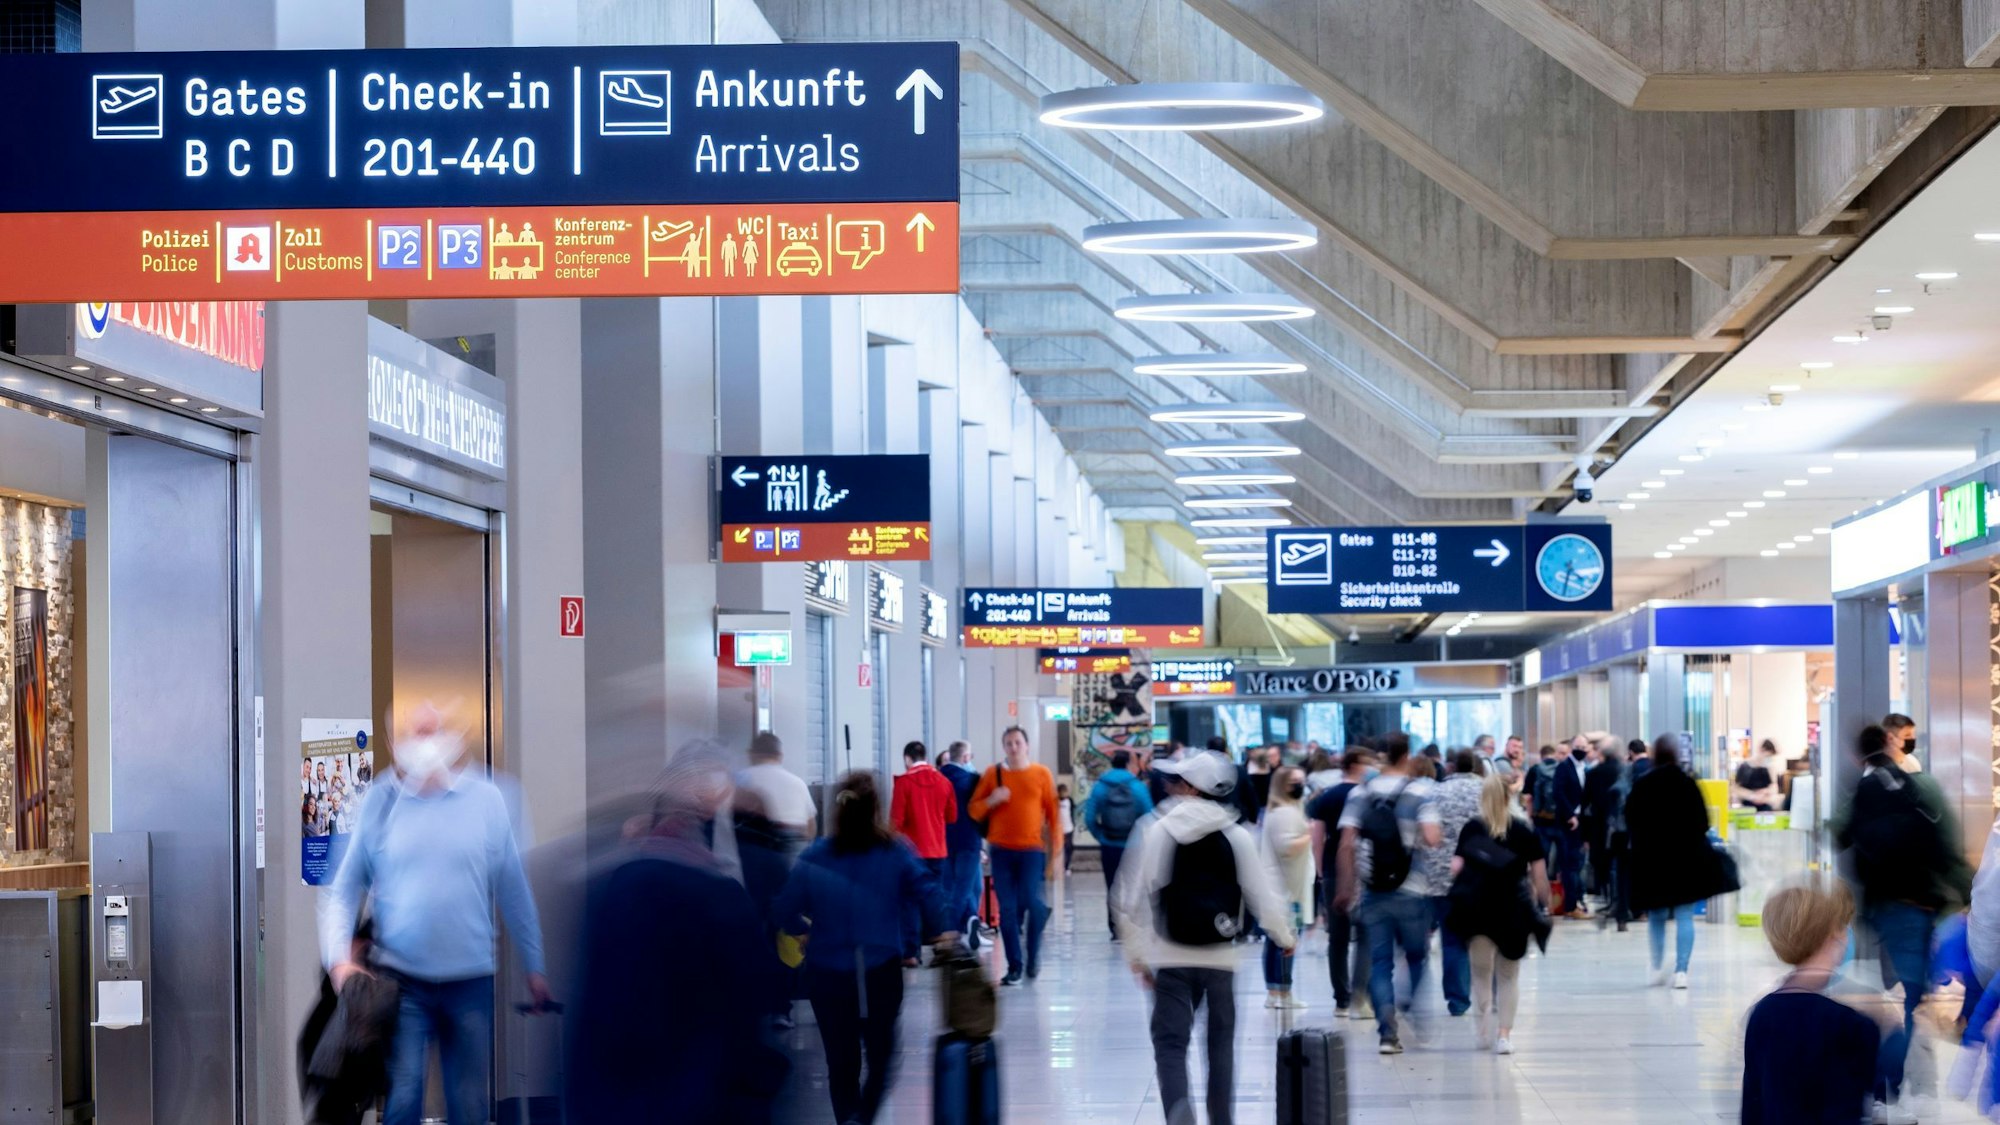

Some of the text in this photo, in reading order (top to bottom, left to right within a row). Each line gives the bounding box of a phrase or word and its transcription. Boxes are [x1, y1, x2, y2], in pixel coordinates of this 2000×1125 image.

[362, 71, 550, 111] Check-in
[695, 68, 867, 107] Ankunft
[185, 78, 307, 116] Gates
[185, 138, 294, 177] B C D
[363, 136, 536, 177] 201-440
[695, 133, 860, 173] Arrivals
[554, 217, 633, 232] Konferenz-
[737, 217, 764, 235] WC
[777, 222, 819, 241] Taxi
[141, 229, 210, 248] Polizei
[284, 228, 323, 247] Zoll
[554, 232, 615, 246] zentrum
[141, 254, 198, 273] Police
[284, 252, 363, 271] Customs
[554, 250, 631, 265] Conference
[554, 265, 601, 279] center
[1339, 533, 1374, 546] Gates
[1392, 548, 1438, 561] C11-73
[1340, 581, 1461, 595] Sicherheitskontrolle
[985, 593, 1035, 606] Check-in
[1067, 593, 1112, 606] Ankunft
[1340, 594, 1423, 609] Security check
[985, 609, 1032, 622] 201-440
[1066, 609, 1111, 622] Arrivals
[1245, 672, 1306, 694] Marc
[1312, 669, 1391, 693] O'Polo
